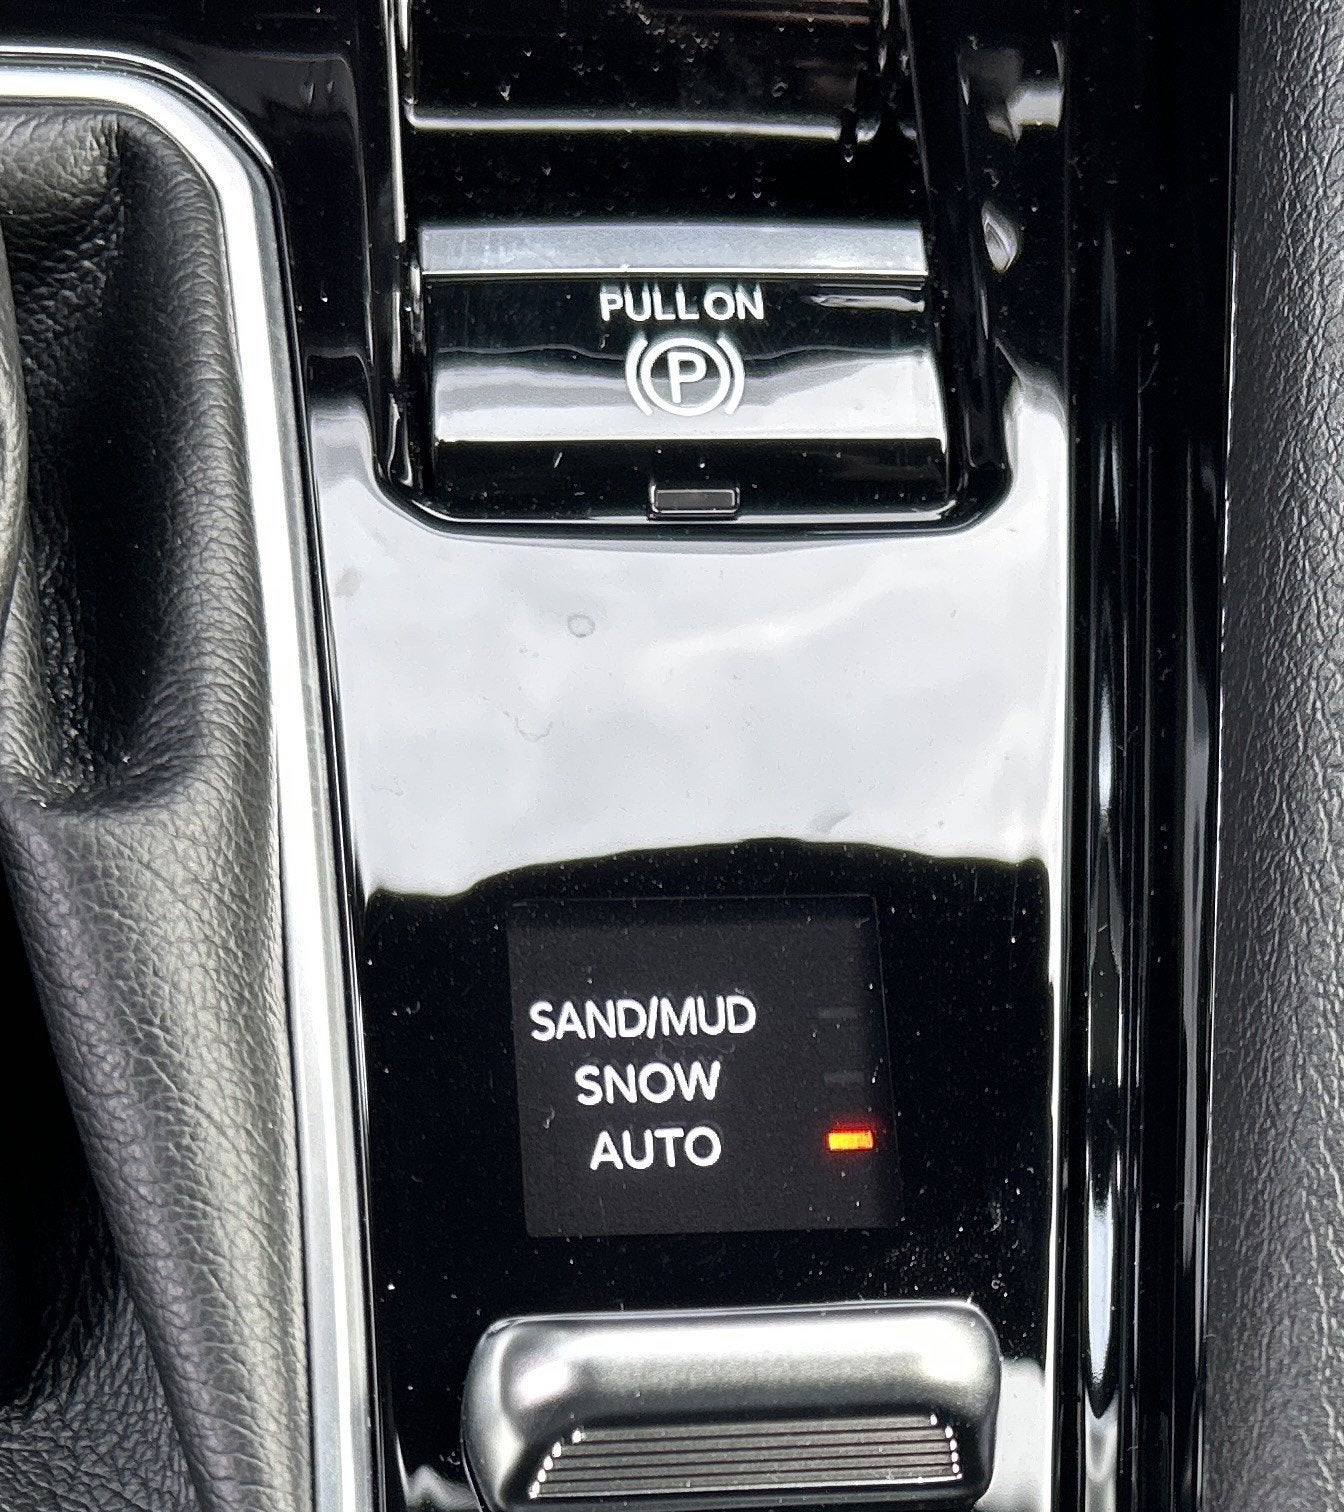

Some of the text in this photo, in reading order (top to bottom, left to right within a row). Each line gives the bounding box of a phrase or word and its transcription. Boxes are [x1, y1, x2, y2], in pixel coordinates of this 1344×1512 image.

[600, 290, 765, 322] PULL ON
[529, 995, 757, 1041] SAND/MUD
[574, 1060, 722, 1106] SNOW
[589, 1125, 723, 1171] AUTO
